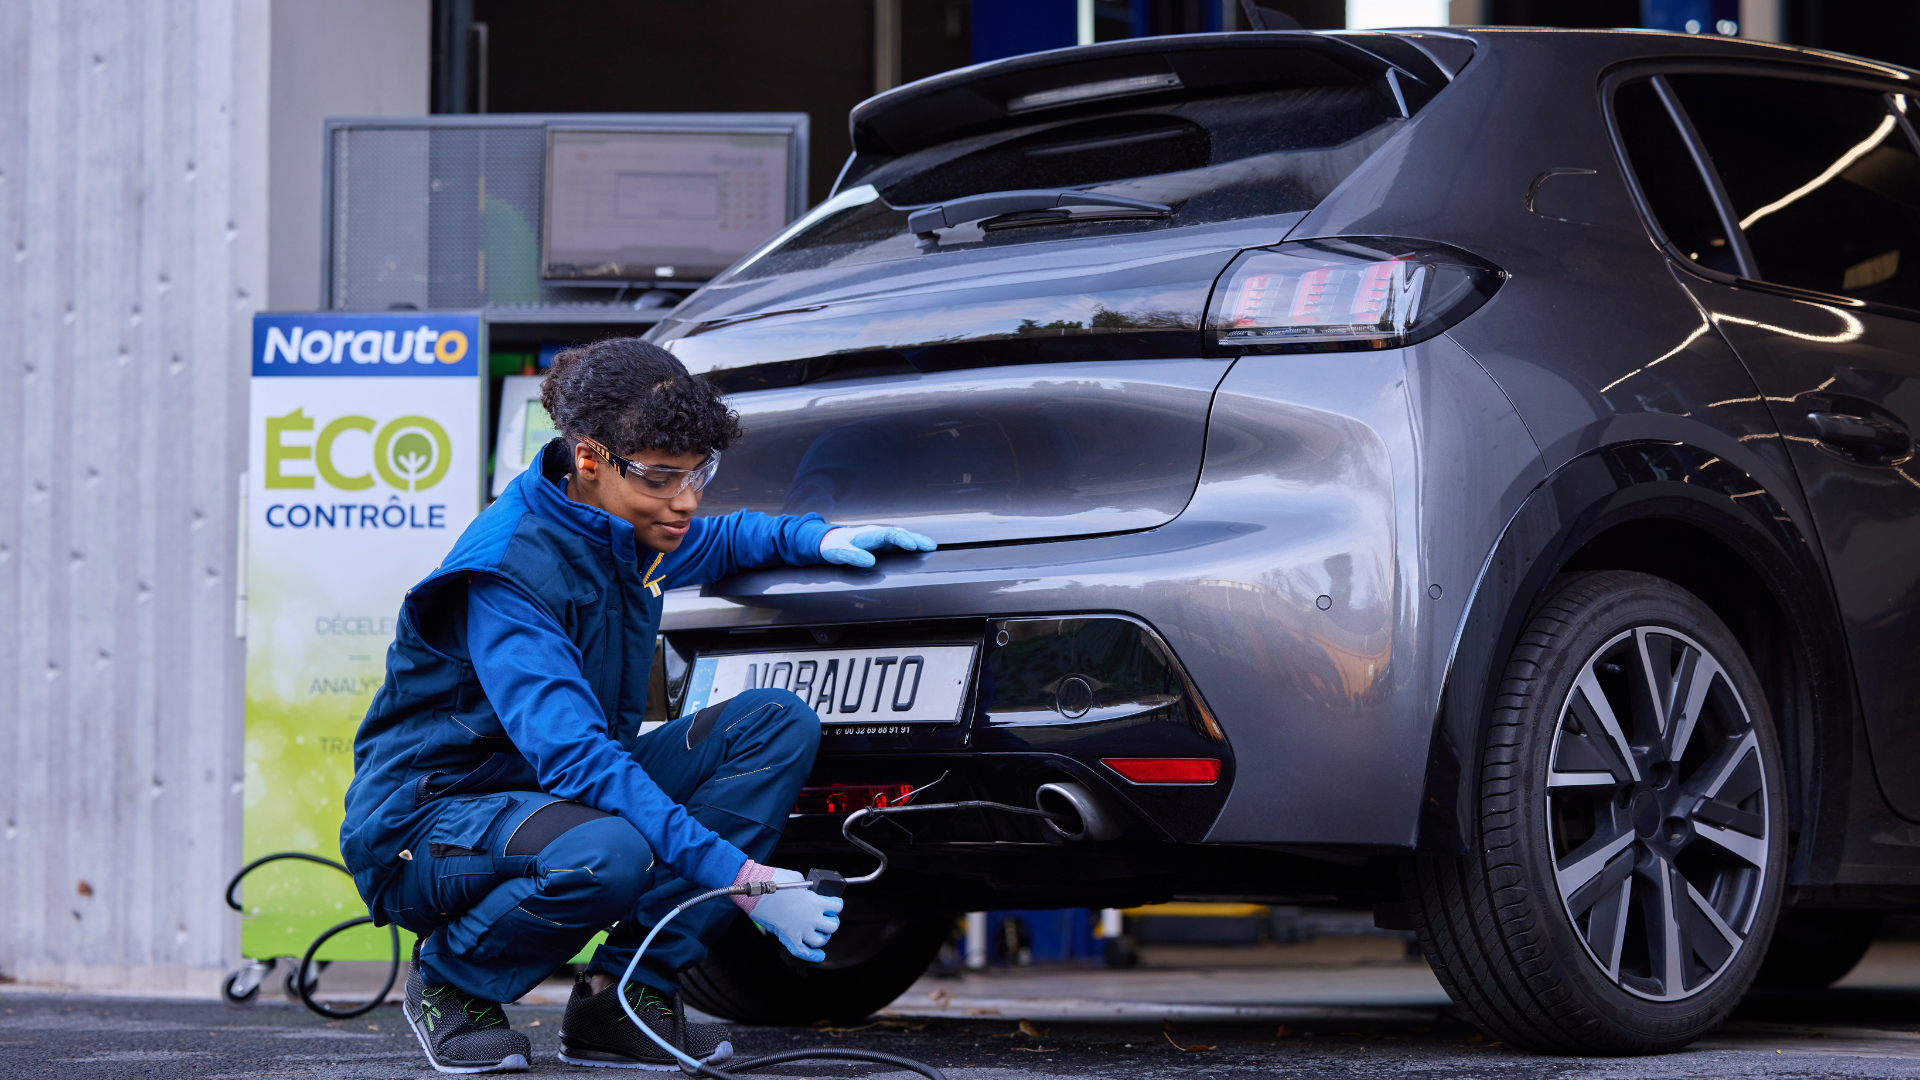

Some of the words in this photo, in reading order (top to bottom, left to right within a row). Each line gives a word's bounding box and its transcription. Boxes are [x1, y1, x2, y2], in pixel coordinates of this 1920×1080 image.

[263, 326, 469, 365] Norauto
[264, 407, 452, 492] ÉCO
[266, 494, 446, 529] CONTRÔLE
[855, 727, 866, 735] 32
